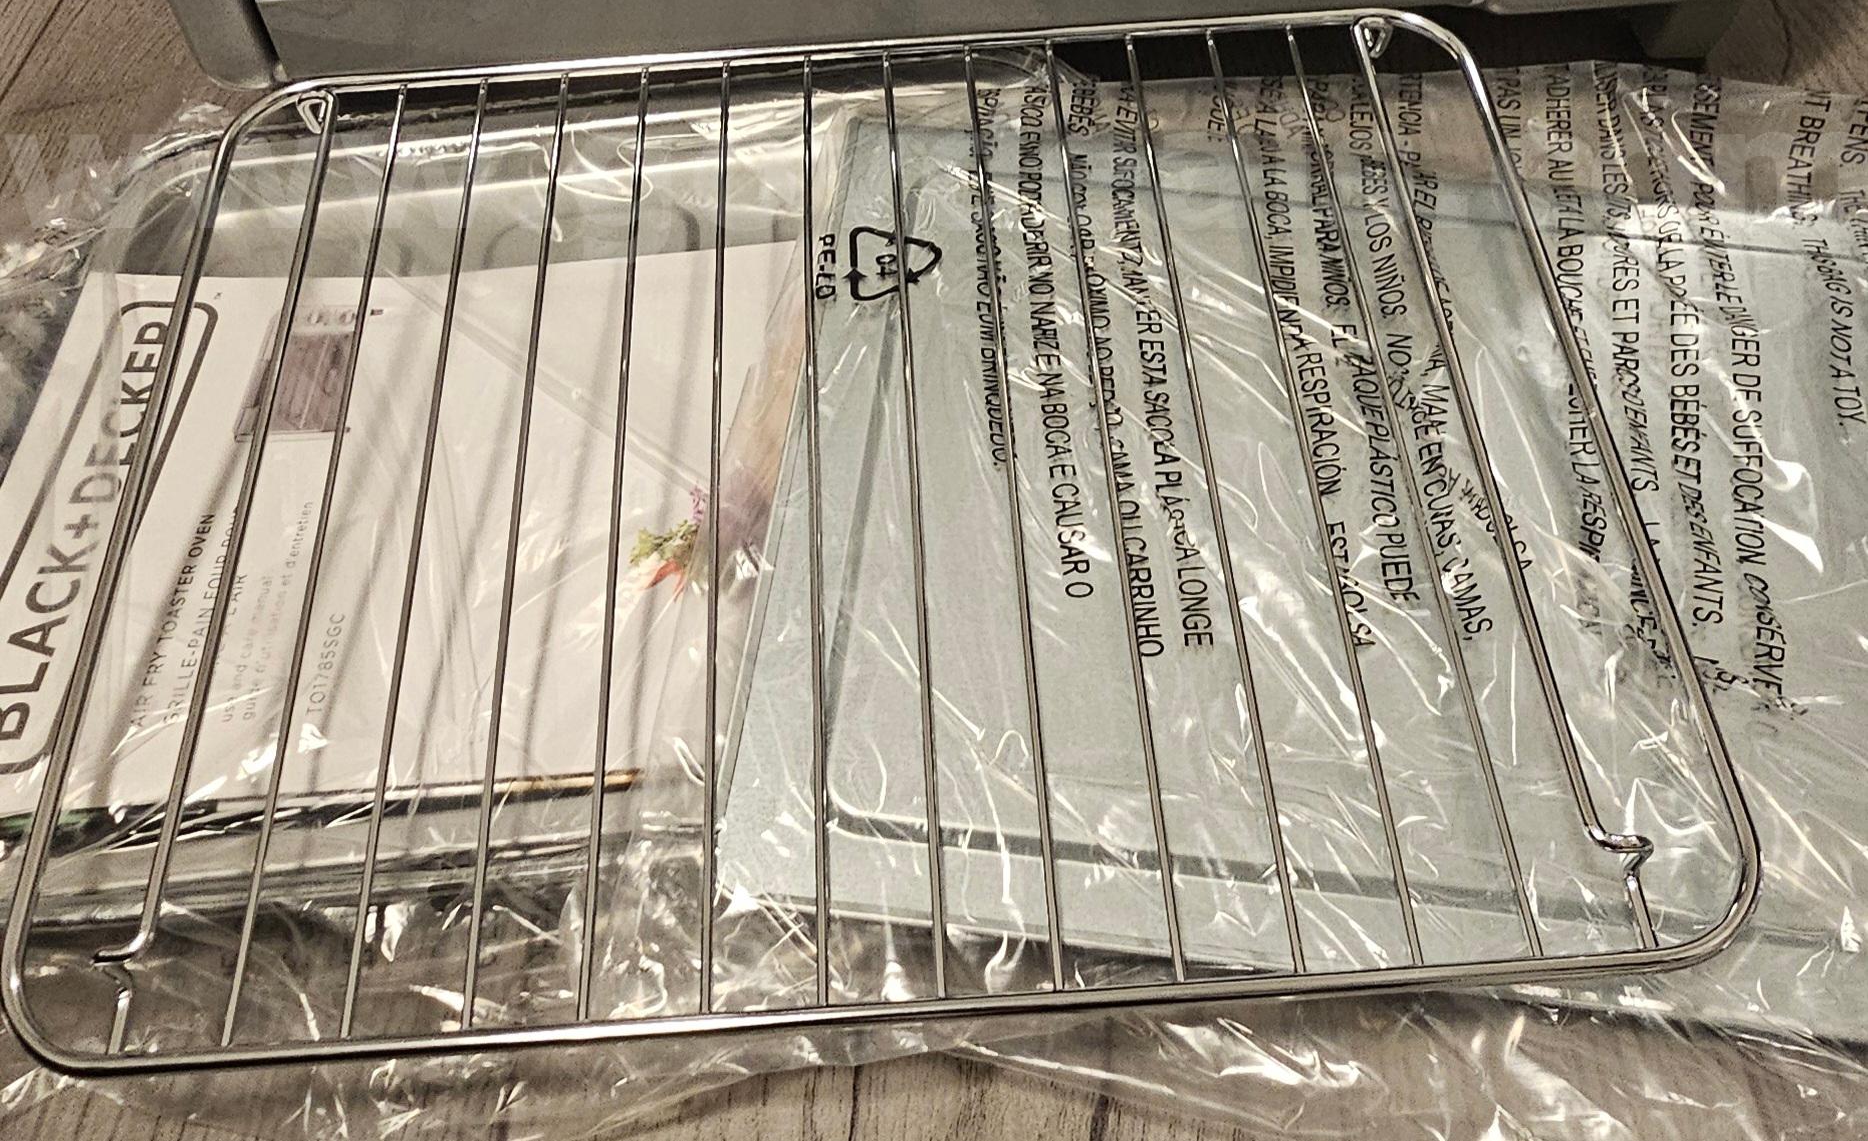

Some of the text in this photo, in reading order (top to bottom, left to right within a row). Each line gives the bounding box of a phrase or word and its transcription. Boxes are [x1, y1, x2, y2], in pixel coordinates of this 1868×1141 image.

[1263, 168, 1287, 188] LA
[1264, 191, 1293, 241] BOCA,
[1365, 216, 1395, 253] LOS
[1028, 271, 1055, 296] NO
[1372, 253, 1408, 321] NIÑOS.
[1030, 301, 1060, 351] NARIZ
[1612, 298, 1640, 324] ET
[1829, 296, 1854, 318] IS
[1035, 353, 1060, 367] E
[1829, 318, 1853, 366] NOT
[1039, 372, 1065, 399] NA
[1732, 373, 1761, 401] DE
[1828, 364, 1856, 379] A
[1832, 386, 1867, 427] TOY.
[1041, 403, 1073, 460] BOCA
[1049, 463, 1077, 479] E
[1362, 420, 1401, 527] PLÁSTICO
[1669, 333, 1701, 377] DES
[1686, 521, 1723, 628] ENFANTS.
[1139, 340, 1168, 385] ESTA
[1177, 566, 1214, 648] LONGE
[1052, 482, 1091, 577] CAUSAR
[1376, 533, 1421, 602] PUEDE
[1064, 582, 1095, 599] O
[1121, 537, 1165, 658] CARRINHO
[130, 513, 216, 728] AIR FRY TOASTER OVEN
